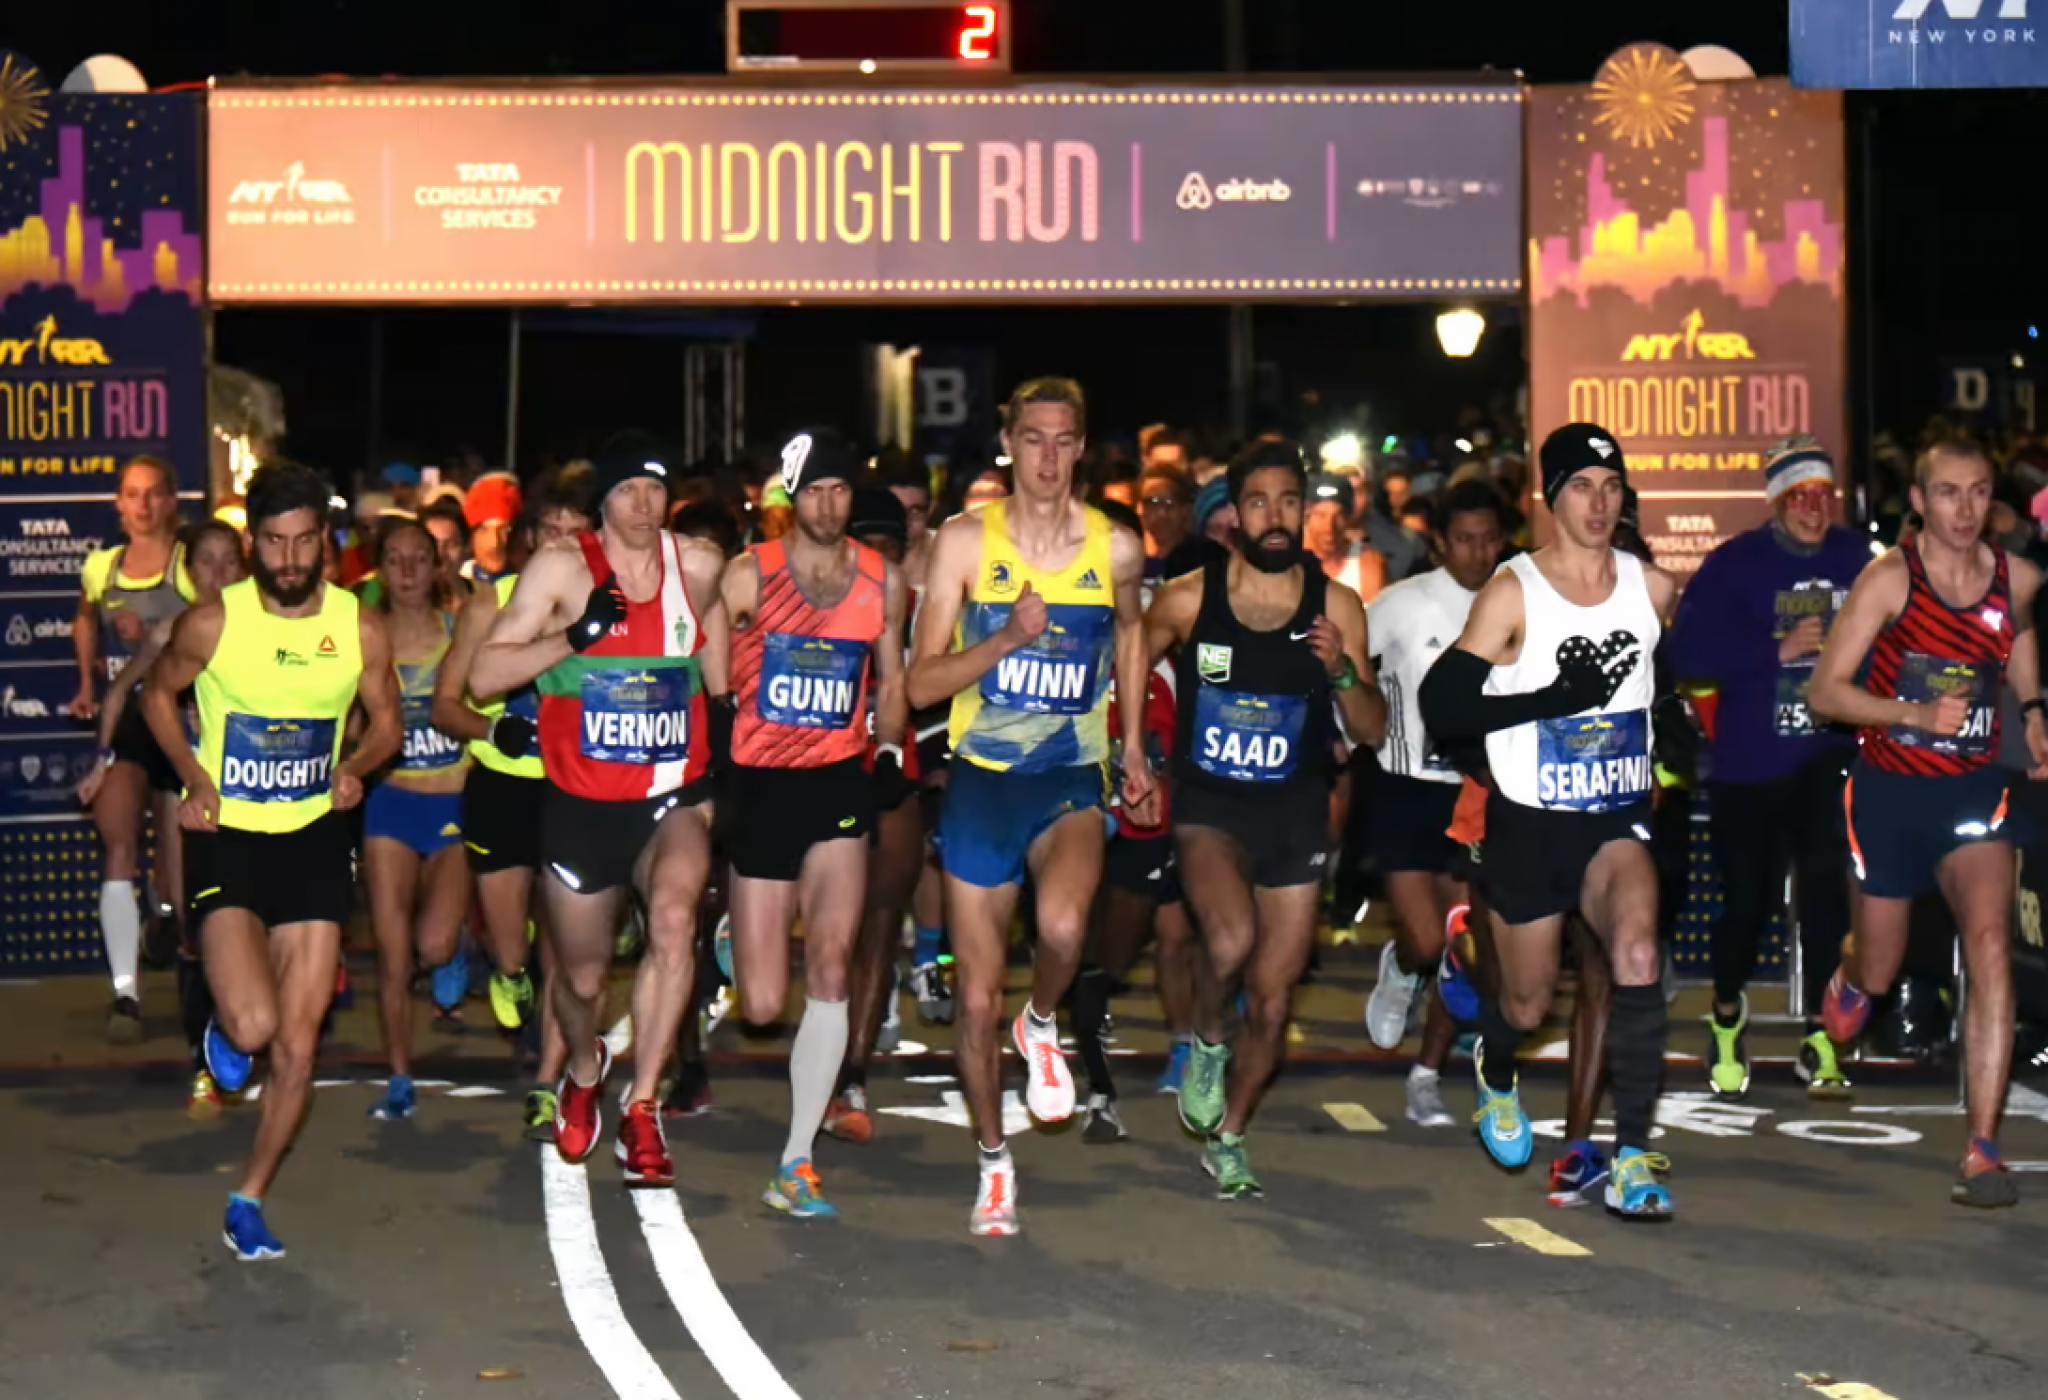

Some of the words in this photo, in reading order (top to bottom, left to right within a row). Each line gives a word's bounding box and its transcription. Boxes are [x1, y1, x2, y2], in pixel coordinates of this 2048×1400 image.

[959, 6, 996, 59] 2
[1888, 29, 1946, 44] NEW
[1964, 29, 2037, 43] YORK
[455, 163, 520, 182] TATA
[414, 185, 562, 206] CONSULTANCY
[625, 141, 964, 244] MIDNIGHT
[978, 140, 1098, 243] RUN
[1215, 178, 1291, 201] airbnb
[441, 208, 537, 229] SERVICES
[0, 379, 95, 440] NIGHT
[102, 379, 168, 439] RUN
[920, 368, 967, 426] B
[1568, 374, 1742, 437] MIDNIGHT
[1748, 374, 1810, 435] RUN
[21, 456, 63, 475] FOR
[69, 455, 116, 474] LIFE
[1669, 454, 1711, 470] FOR
[1715, 453, 1760, 470] LIFE
[20, 518, 71, 536] TATA
[1666, 515, 1715, 533] TATA
[0, 537, 103, 556] ONSULTANCY
[997, 657, 1087, 699] WINN
[768, 674, 854, 714] GUNN
[584, 710, 687, 747] VERNON
[1203, 726, 1289, 768] SAAD
[224, 752, 331, 790] DOUGHTY
